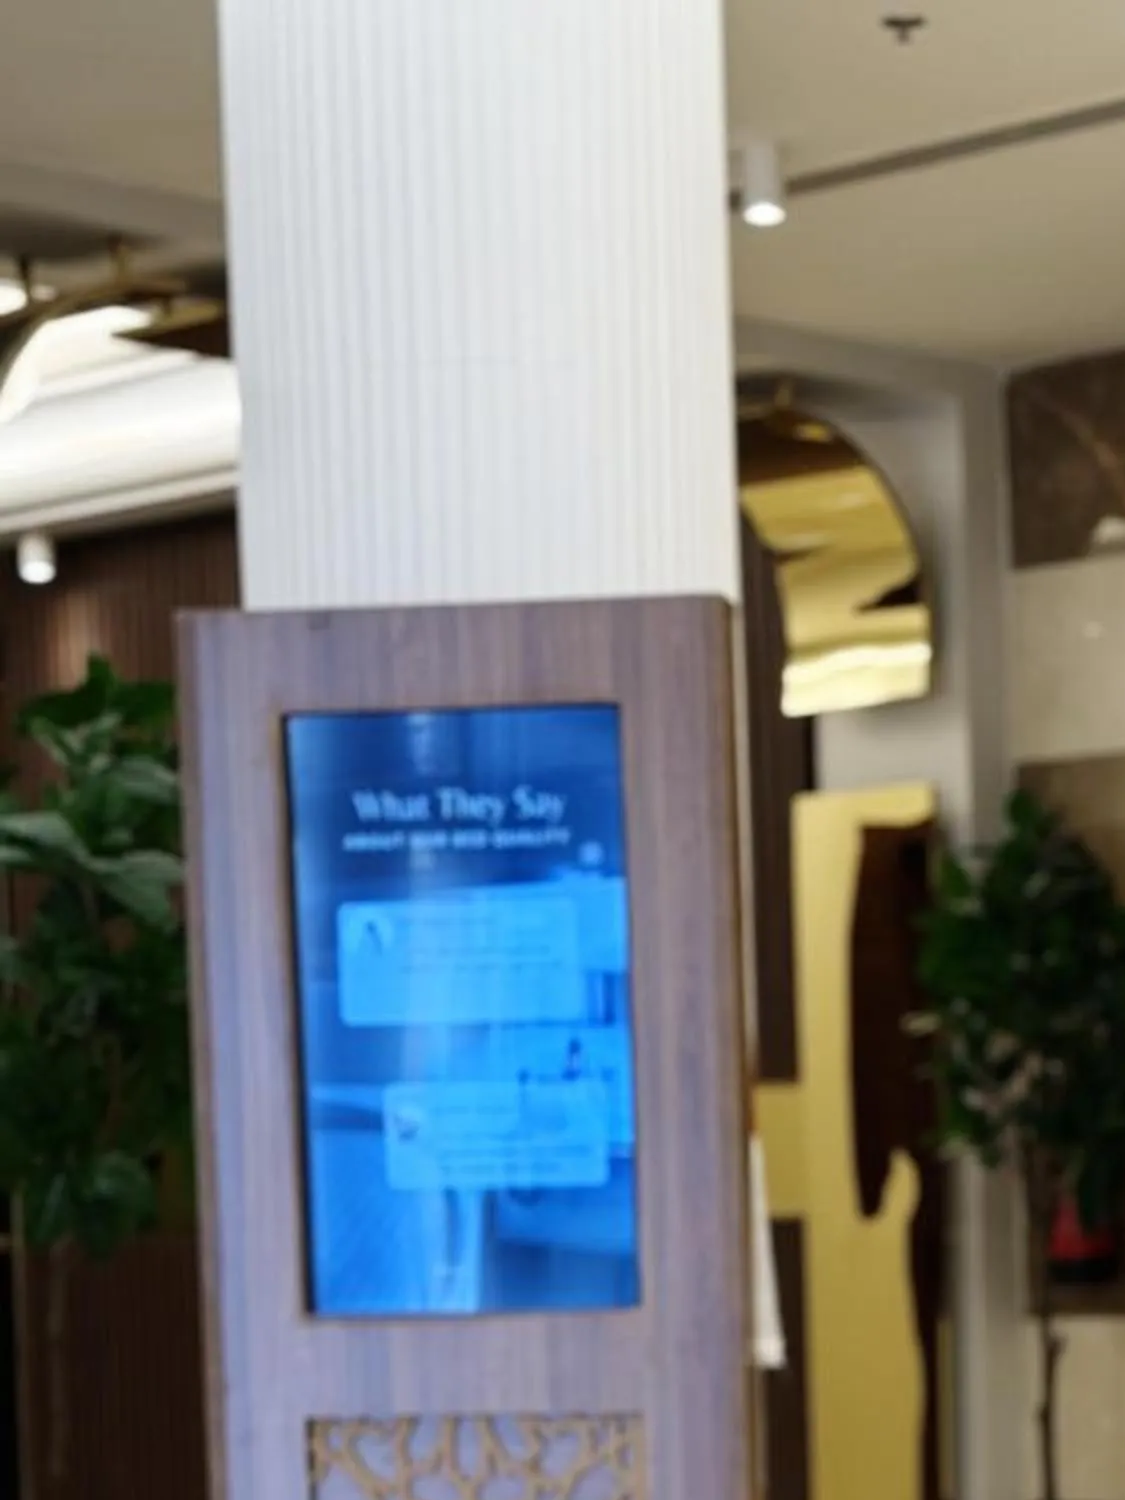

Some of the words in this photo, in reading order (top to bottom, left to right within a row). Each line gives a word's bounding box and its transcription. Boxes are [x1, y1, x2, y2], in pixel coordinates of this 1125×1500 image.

[352, 789, 429, 822] What
[435, 787, 505, 827] They
[512, 784, 567, 825] Say
